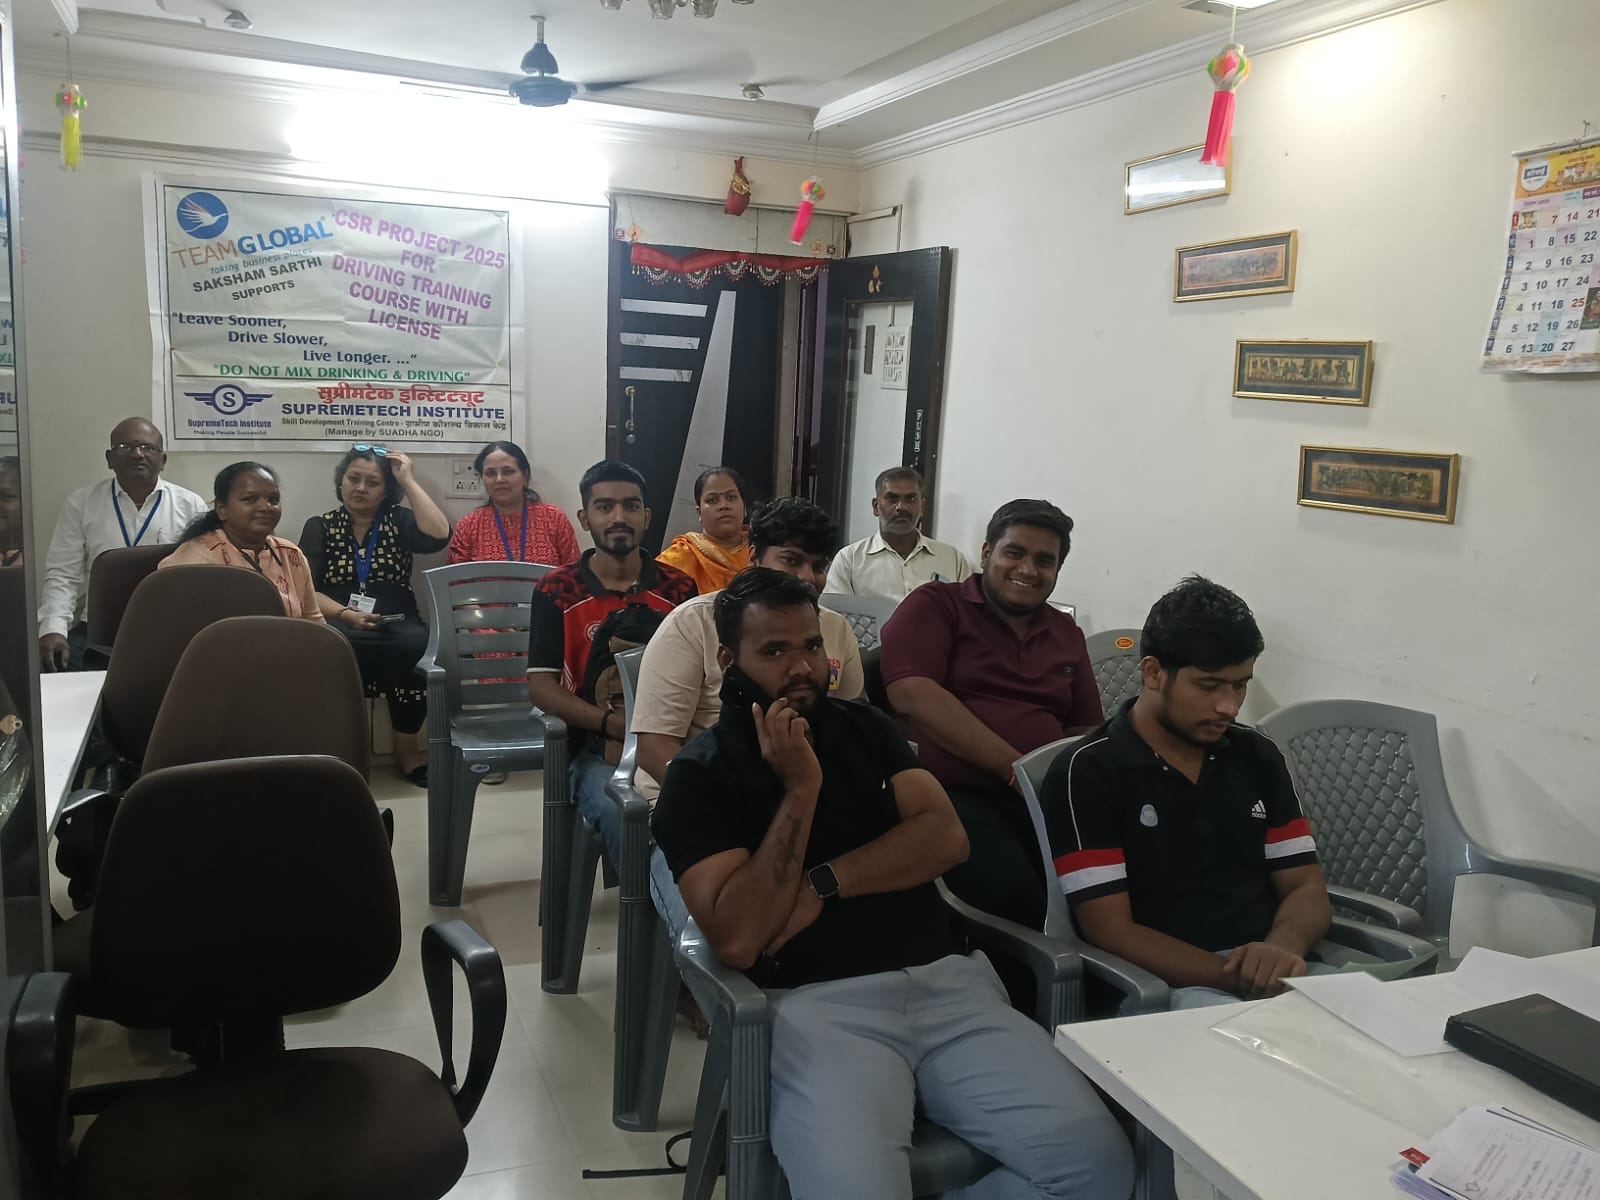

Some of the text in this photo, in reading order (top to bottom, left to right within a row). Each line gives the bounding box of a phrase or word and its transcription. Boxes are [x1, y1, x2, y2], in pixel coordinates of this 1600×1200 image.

[1552, 207, 1600, 224] 7 14 21
[335, 208, 506, 269] CSR PROJECT 2025
[1529, 230, 1597, 248] 1 8 15 22
[242, 254, 281, 268] business
[400, 250, 437, 273] FOR
[1525, 261, 1532, 270] 2
[1545, 258, 1552, 268] 9
[1560, 256, 1572, 266] 16
[1580, 253, 1594, 264] 23
[192, 256, 322, 292] SAKSHAM SARTHI
[332, 254, 492, 309] DRIVING TRAINING
[232, 279, 295, 300] SUPPORTS
[1521, 282, 1528, 291] 3
[1536, 280, 1548, 289] 10
[1556, 278, 1568, 287] 17
[1576, 275, 1590, 286] 24
[350, 281, 469, 326] COURSE WITH
[1516, 303, 1524, 312] 4
[1531, 302, 1542, 311] 11
[1551, 299, 1564, 309] 18
[1571, 297, 1585, 308] 25
[228, 315, 287, 329] Sooner,
[368, 308, 442, 340] LICENSE
[1511, 323, 1519, 333] 5
[1526, 323, 1539, 332] 12
[1546, 321, 1559, 331] 19
[1566, 319, 1580, 330] 26
[228, 331, 328, 347] Drive Slower,
[1505, 341, 1575, 353] 6 13 20 27
[303, 350, 332, 362] Live
[248, 365, 280, 377] NOT
[284, 366, 312, 378] MIX
[318, 367, 388, 380] DRINKING
[393, 369, 402, 380] &
[281, 403, 505, 420] SUPREMETECH INSTITUTE
[299, 418, 345, 427] Development
[346, 418, 375, 427] Training
[365, 428, 377, 437] by
[378, 428, 418, 437] SUADHA
[420, 429, 444, 438] NGO)
